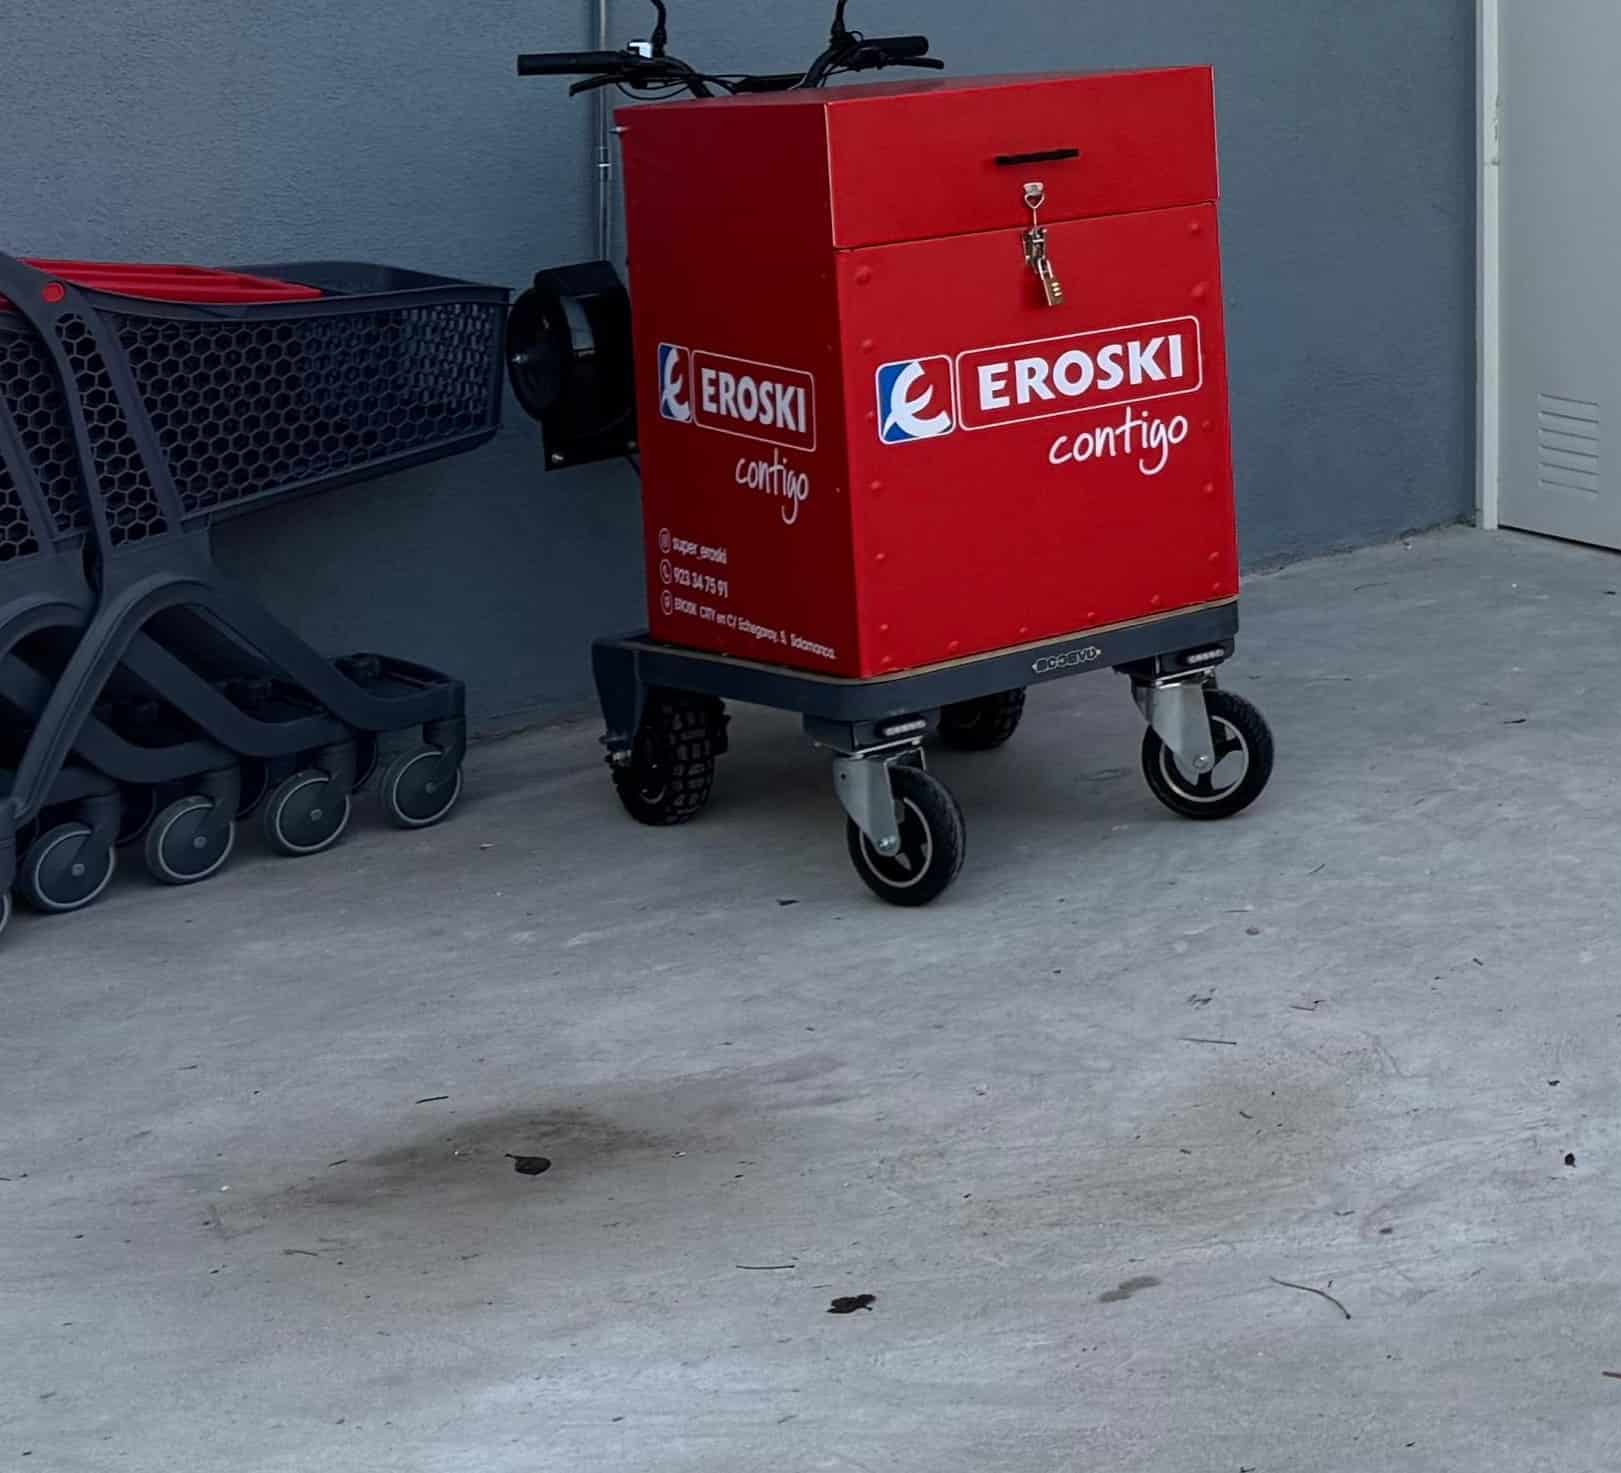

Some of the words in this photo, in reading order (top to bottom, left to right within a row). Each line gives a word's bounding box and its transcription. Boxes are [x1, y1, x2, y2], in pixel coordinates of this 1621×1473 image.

[700, 367, 807, 434] EROSKI
[977, 333, 1184, 412] EROSKI
[1048, 406, 1189, 476] contigo
[735, 447, 809, 525] contigo
